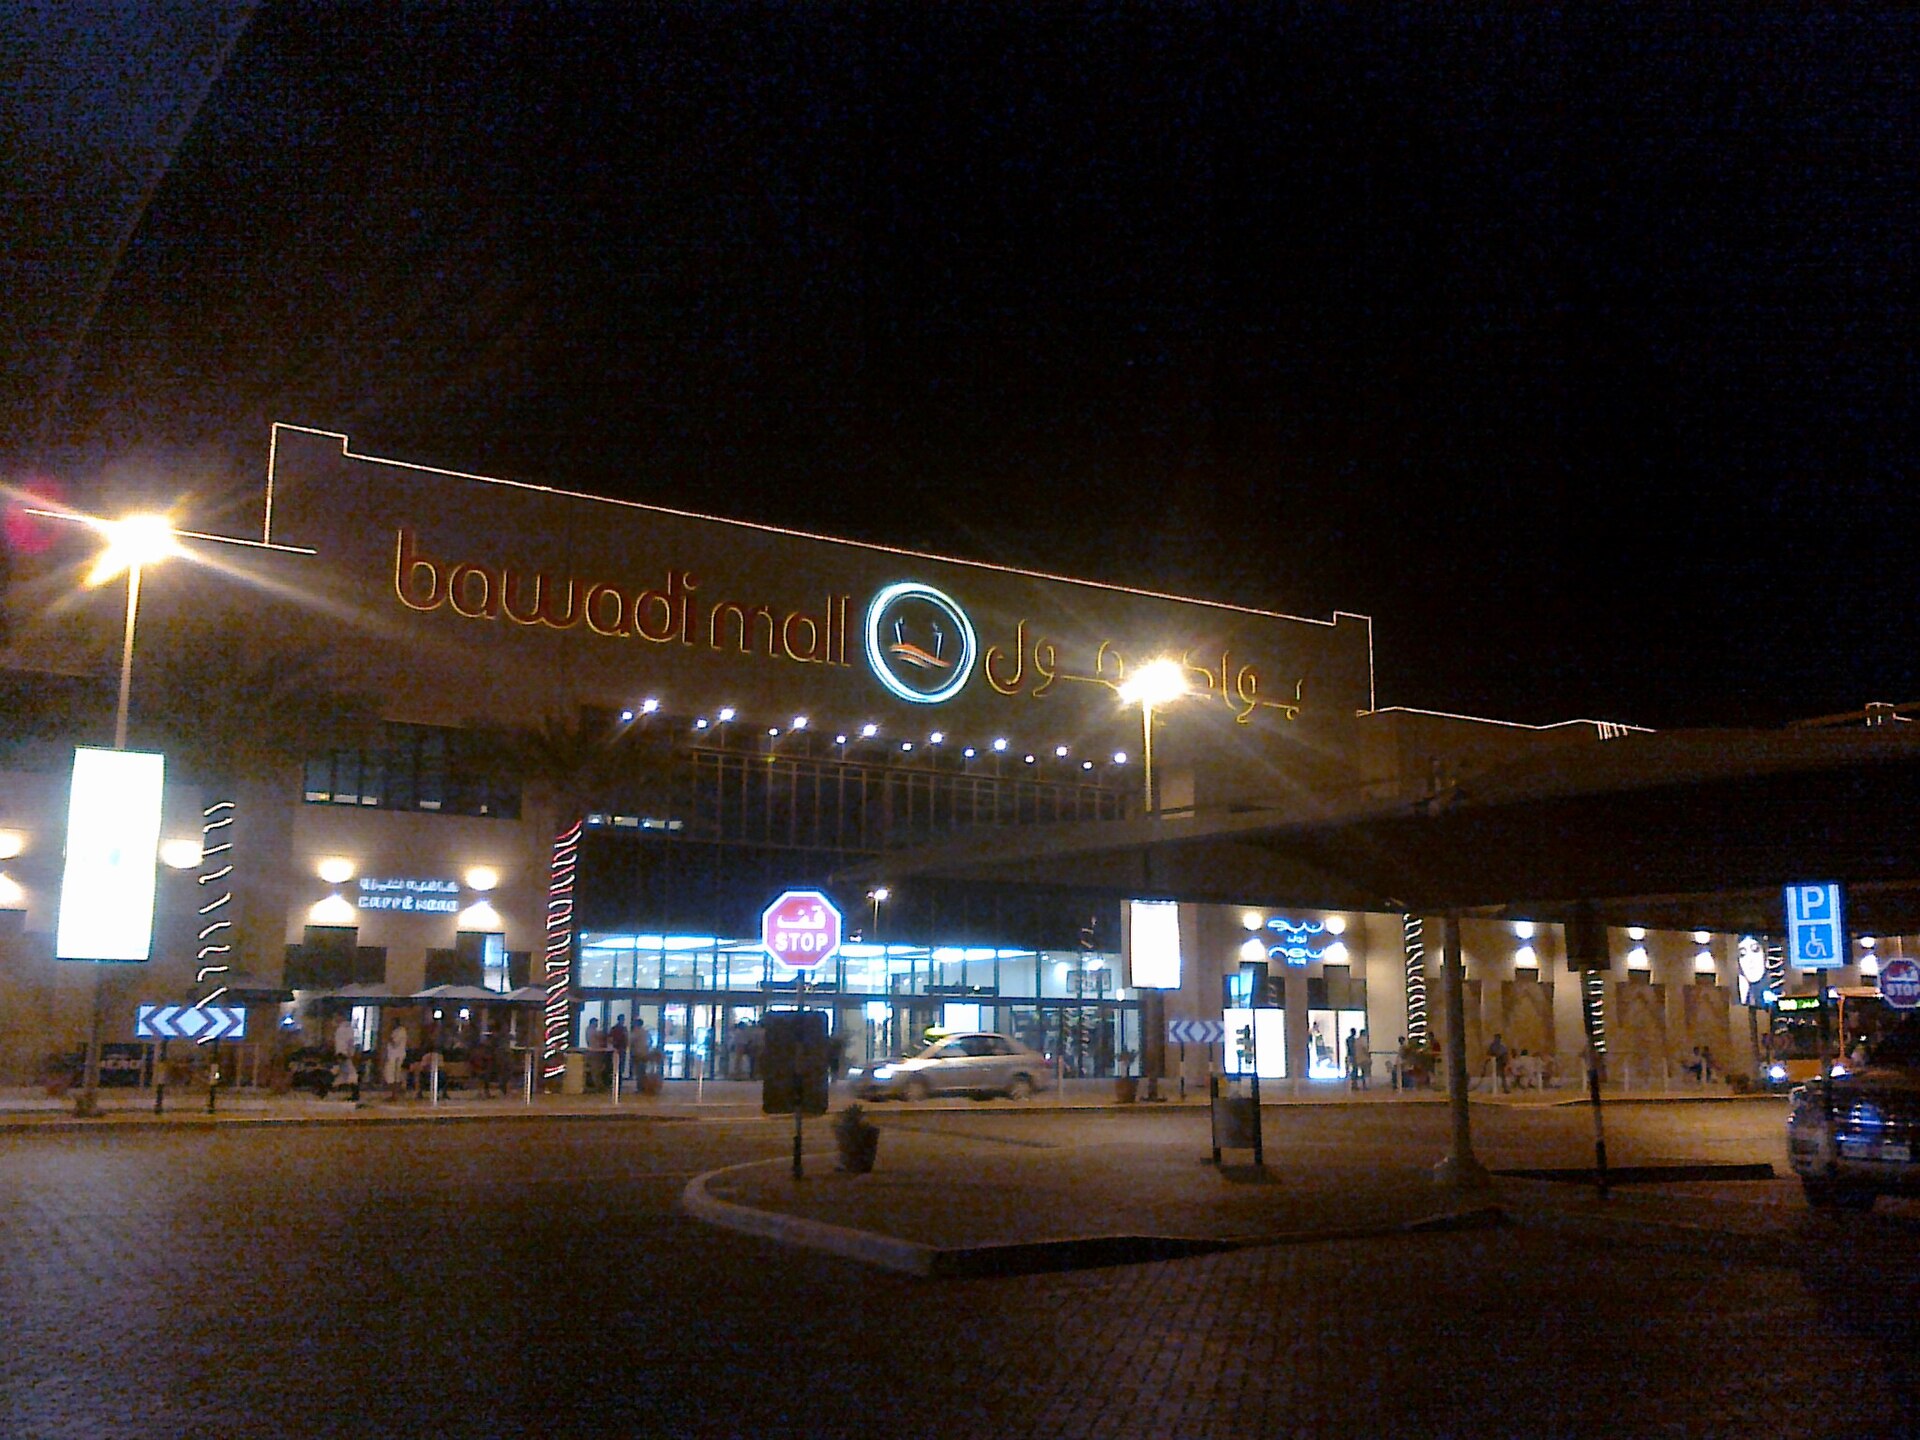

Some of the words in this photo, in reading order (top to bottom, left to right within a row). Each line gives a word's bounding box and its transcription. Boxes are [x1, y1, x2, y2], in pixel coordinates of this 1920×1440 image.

[394, 529, 698, 646] bawadi
[709, 595, 852, 667] mall
[1801, 885, 1825, 919] P
[776, 904, 827, 930] قف
[775, 931, 829, 952] STOP
[1886, 983, 1920, 996] STOP
